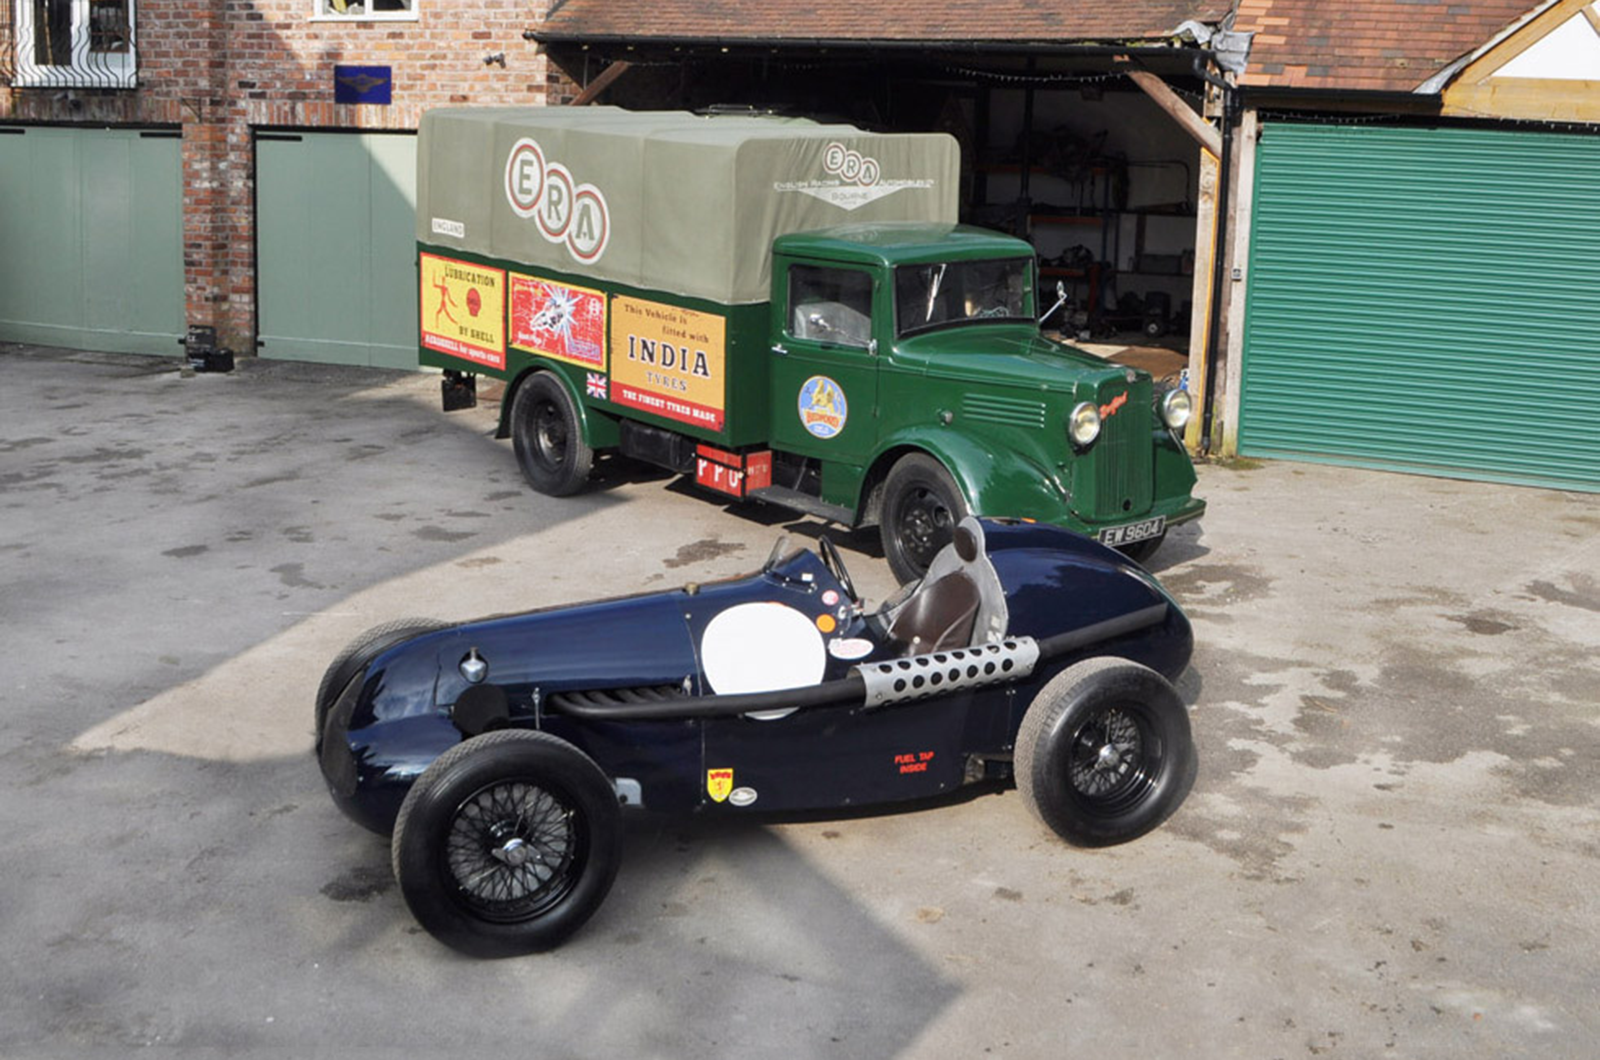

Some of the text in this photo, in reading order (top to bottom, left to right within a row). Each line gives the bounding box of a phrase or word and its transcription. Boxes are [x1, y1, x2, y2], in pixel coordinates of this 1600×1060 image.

[433, 220, 463, 236] ENGLAND
[444, 265, 496, 288] LUBRICATION
[624, 304, 643, 316] This
[645, 308, 677, 323] Vehicle
[458, 325, 495, 344] BY SHELL
[662, 325, 709, 343] fitted with
[629, 335, 710, 377] INDIA
[646, 371, 688, 392] TYRES
[622, 389, 717, 423] THE FINEST TYRES MADE
[1104, 521, 1161, 545] EW 9604
[894, 754, 915, 765] FUEL
[899, 762, 928, 774] INSIDE
